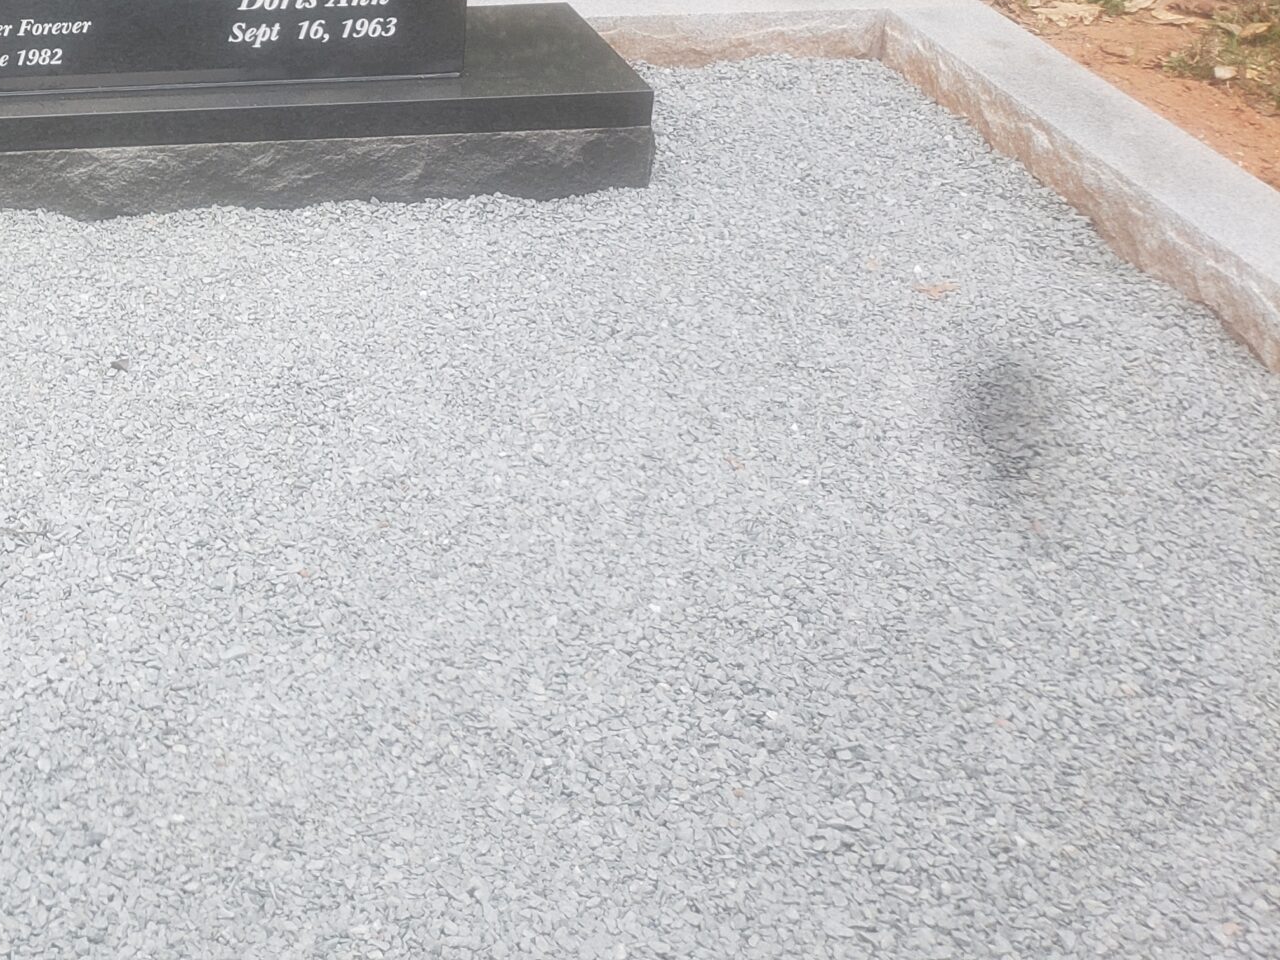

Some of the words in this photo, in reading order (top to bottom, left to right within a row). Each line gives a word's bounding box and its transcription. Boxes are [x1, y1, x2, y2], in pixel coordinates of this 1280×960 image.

[16, 18, 92, 37] Forever
[228, 22, 281, 48] Sept
[297, 19, 330, 43] 16,
[341, 17, 398, 39] 1963
[16, 48, 63, 66] 1982
